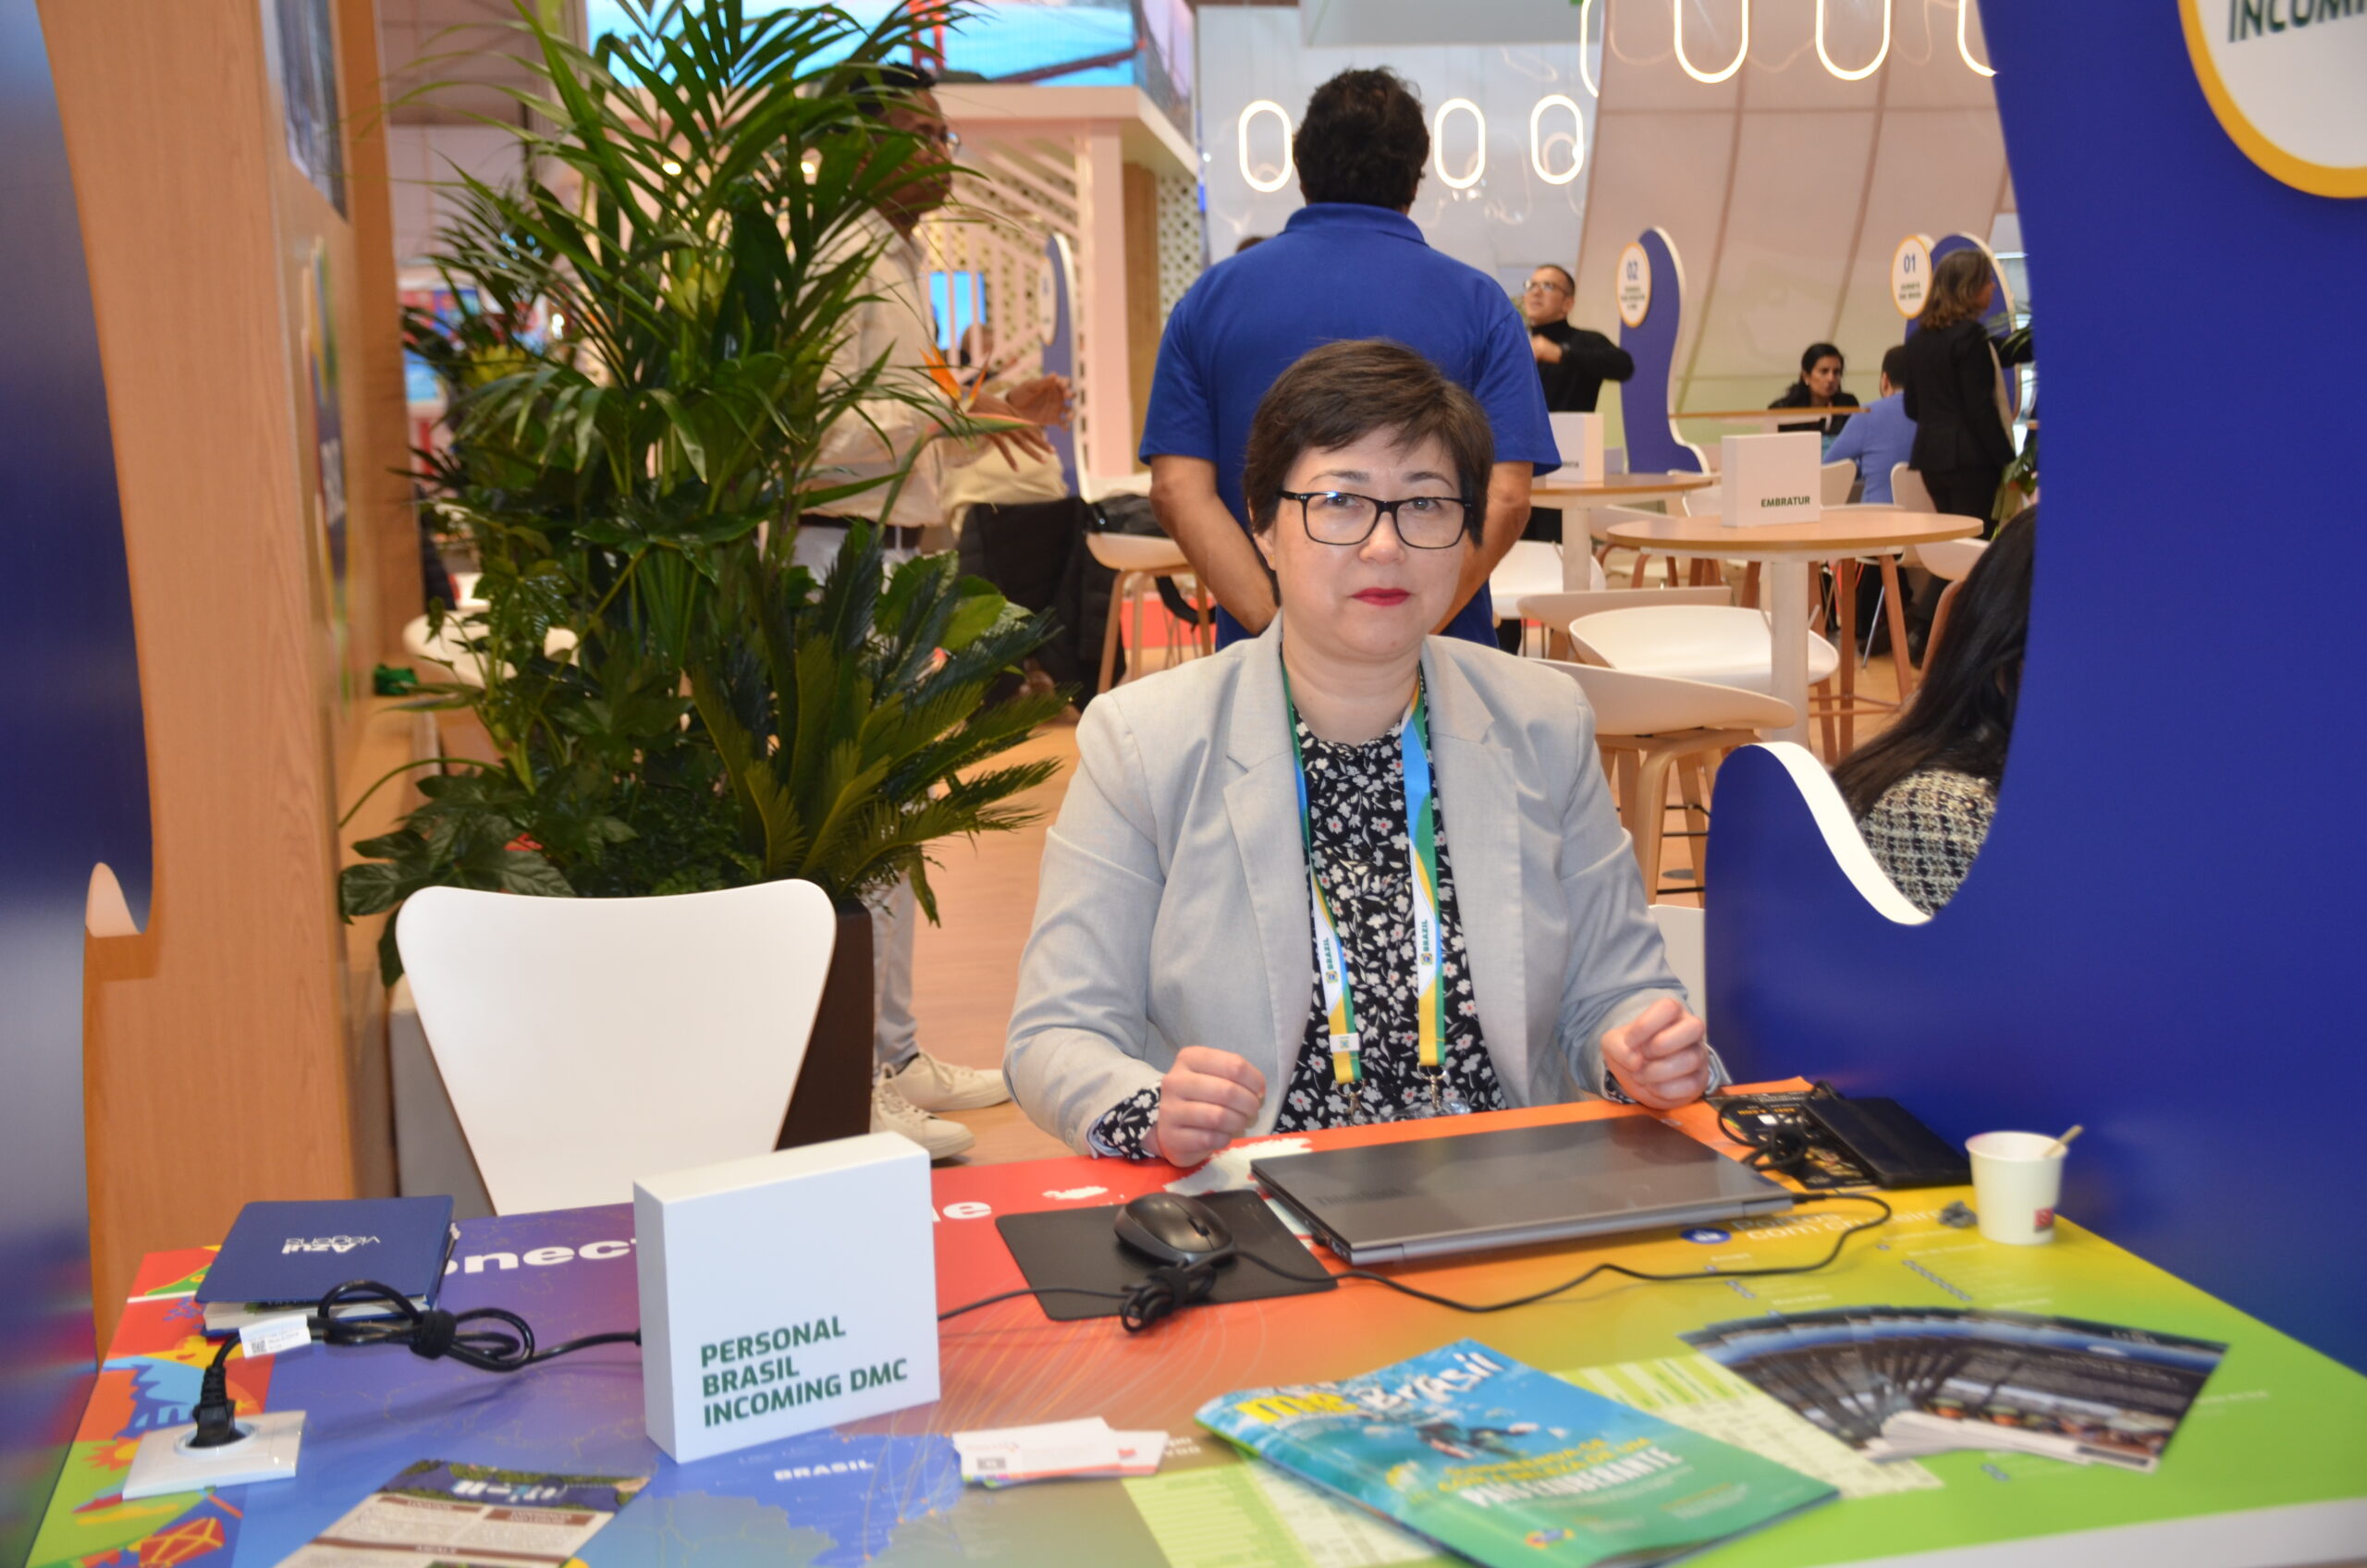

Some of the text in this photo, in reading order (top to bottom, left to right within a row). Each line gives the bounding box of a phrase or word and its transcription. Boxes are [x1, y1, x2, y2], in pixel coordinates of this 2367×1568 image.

[1903, 254, 1916, 274] 01
[1760, 496, 1810, 508] EMBRATUR
[1421, 919, 1429, 951] BRAZIL
[1323, 937, 1333, 970] BRAZIL
[444, 1238, 636, 1275] nec
[701, 1316, 846, 1368] PERSONAL
[703, 1355, 800, 1397] BRASIL
[704, 1357, 908, 1427] INCOMING DMC
[774, 1459, 874, 1481] BRASIL
